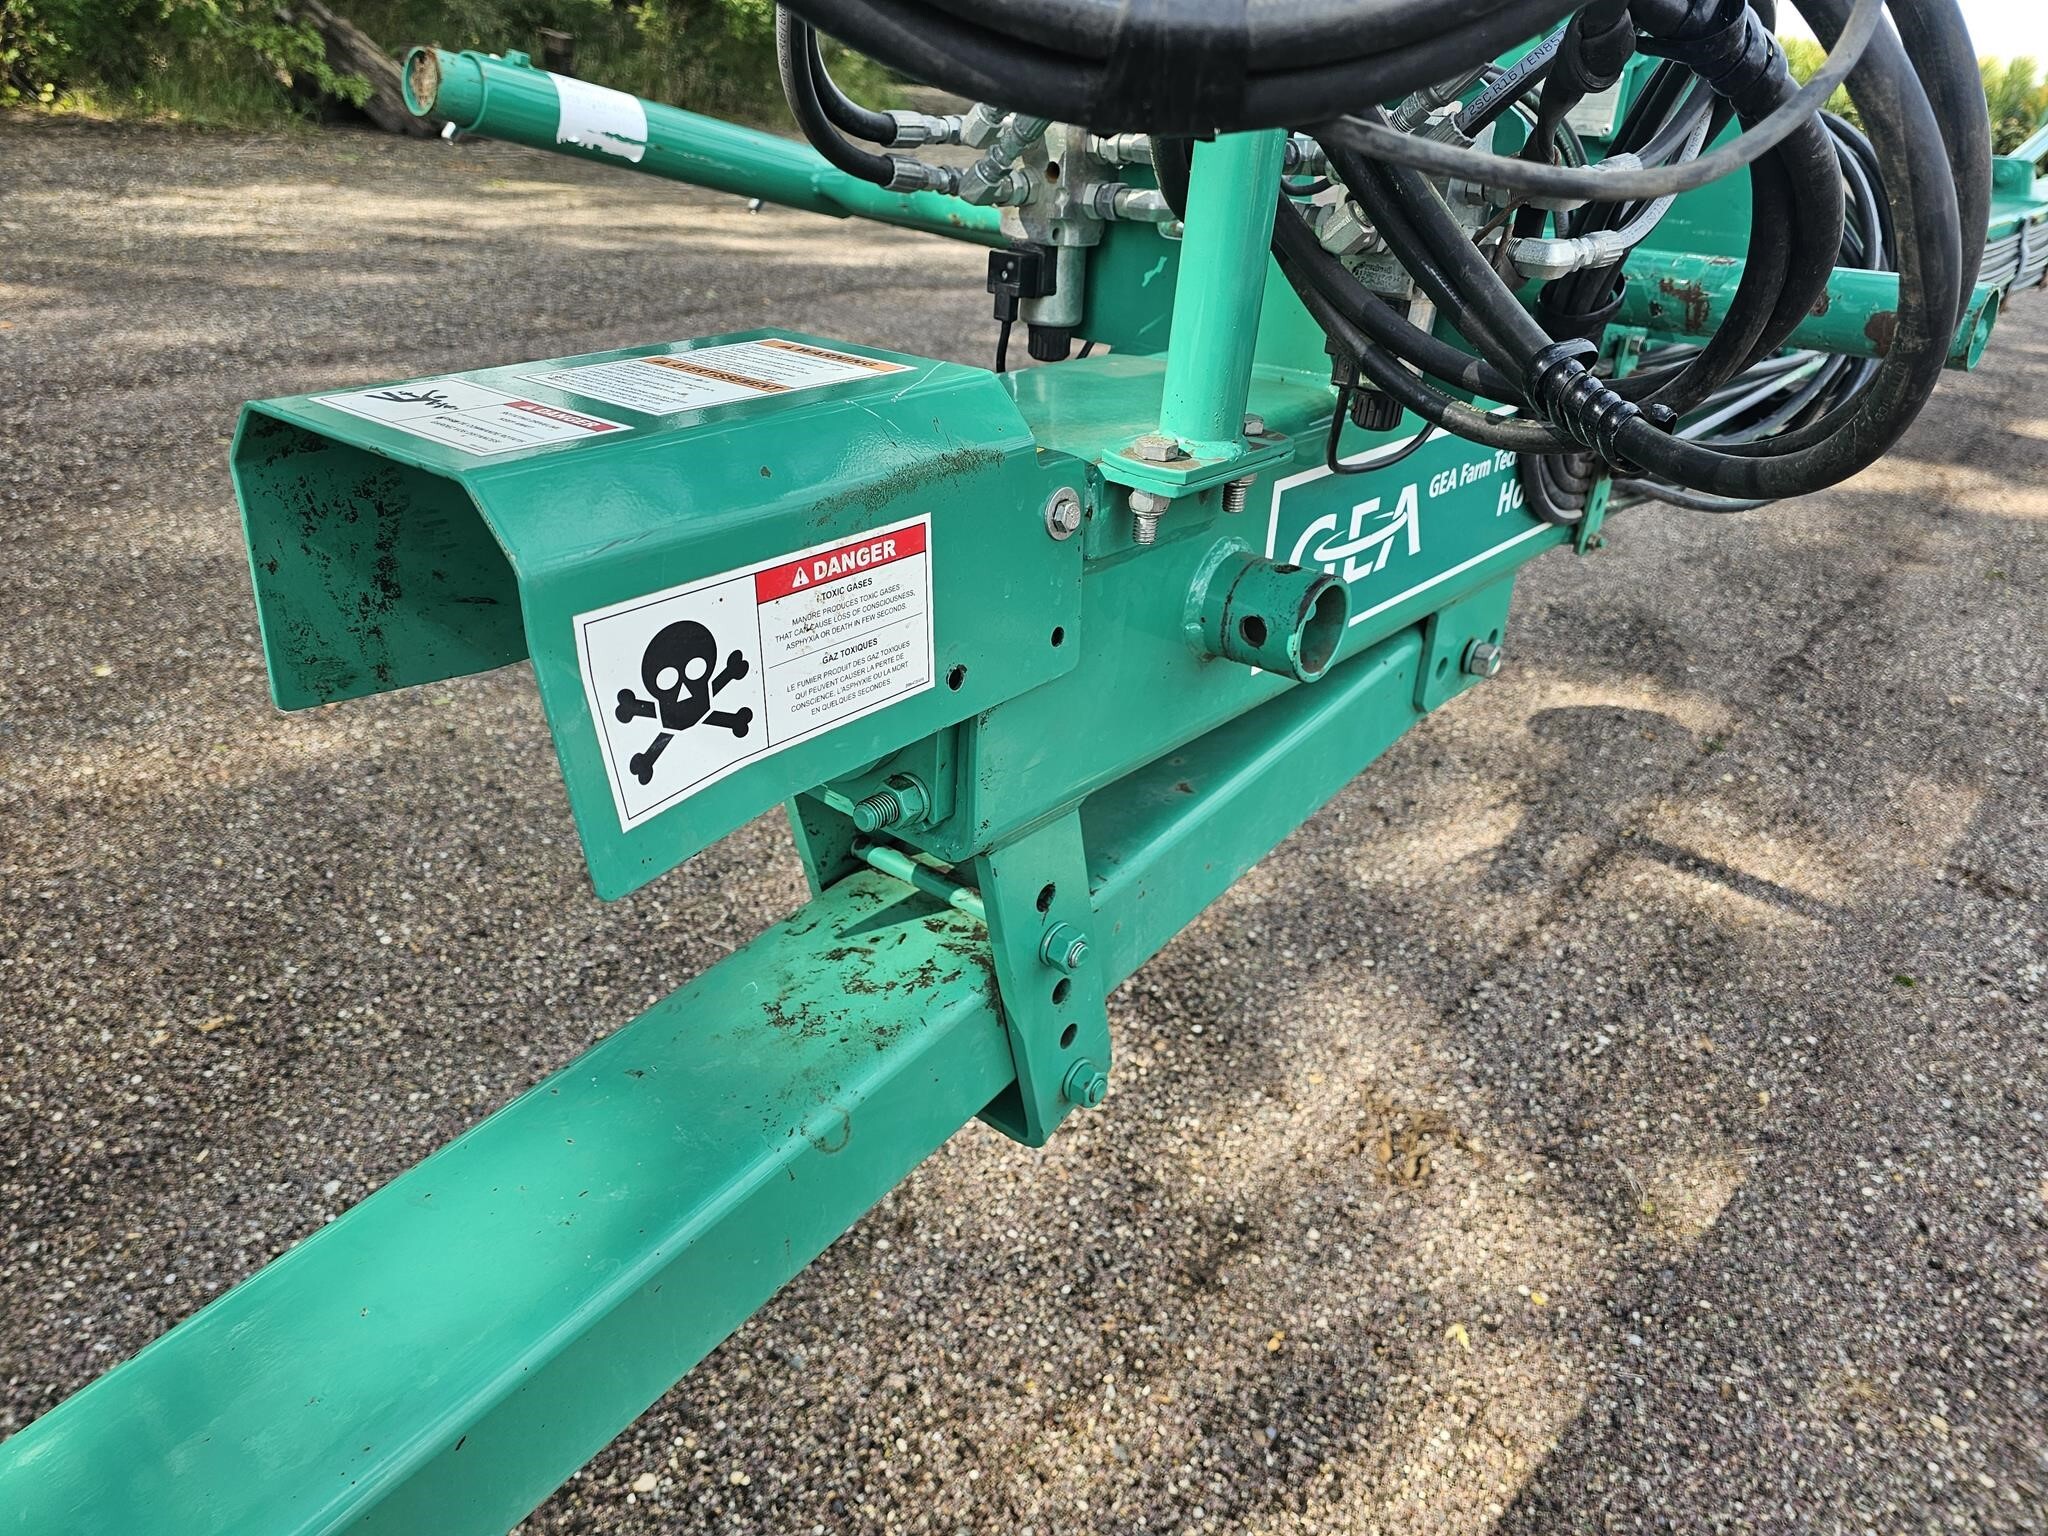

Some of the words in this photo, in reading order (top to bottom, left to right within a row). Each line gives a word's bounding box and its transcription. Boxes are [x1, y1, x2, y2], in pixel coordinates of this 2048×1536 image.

[1468, 92, 1491, 115] 2SC
[1492, 71, 1518, 94] R16
[798, 347, 879, 368] WARNING
[672, 362, 784, 391] AVERTISSEMENT
[534, 408, 599, 427] DANGER
[1429, 467, 1457, 498] GEA
[1459, 459, 1491, 487] Farm
[1289, 483, 1421, 583] GEA
[813, 541, 897, 580] DANGER
[821, 587, 845, 601] TOXIC
[846, 577, 873, 592] GASES
[822, 600, 859, 616] PRODUCES
[860, 592, 879, 603] TOXIC
[879, 583, 901, 596] GASES
[775, 632, 793, 644] THAT
[811, 618, 832, 633] CAUSE
[833, 612, 851, 624] LOSS
[852, 608, 861, 618] OF
[786, 635, 819, 651] ASPHYXIA
[820, 630, 831, 640] OR
[832, 621, 853, 636] DEATH
[854, 618, 861, 628] IN
[862, 612, 876, 624] FEW
[786, 684, 796, 693] LE
[797, 674, 822, 689] FUMIER
[823, 662, 852, 678] PRODUIT
[853, 657, 866, 668] DES
[867, 652, 880, 663] GAZ
[881, 640, 911, 656] TOXIQUES
[822, 653, 839, 665] GAZ
[840, 637, 878, 658] TOXIQUES
[795, 690, 808, 701] QUI
[808, 678, 839, 695] PEUVENT
[840, 667, 866, 683] CAUSER
[867, 664, 875, 673] LA
[875, 657, 895, 671] PERTE
[896, 653, 905, 661] DE
[837, 675, 872, 695] L'ASPHYXIE
[873, 670, 883, 680] OU
[883, 668, 892, 676] LA
[892, 661, 910, 673] MORT
[811, 707, 821, 716] EN
[822, 692, 857, 711] QUELQUES
